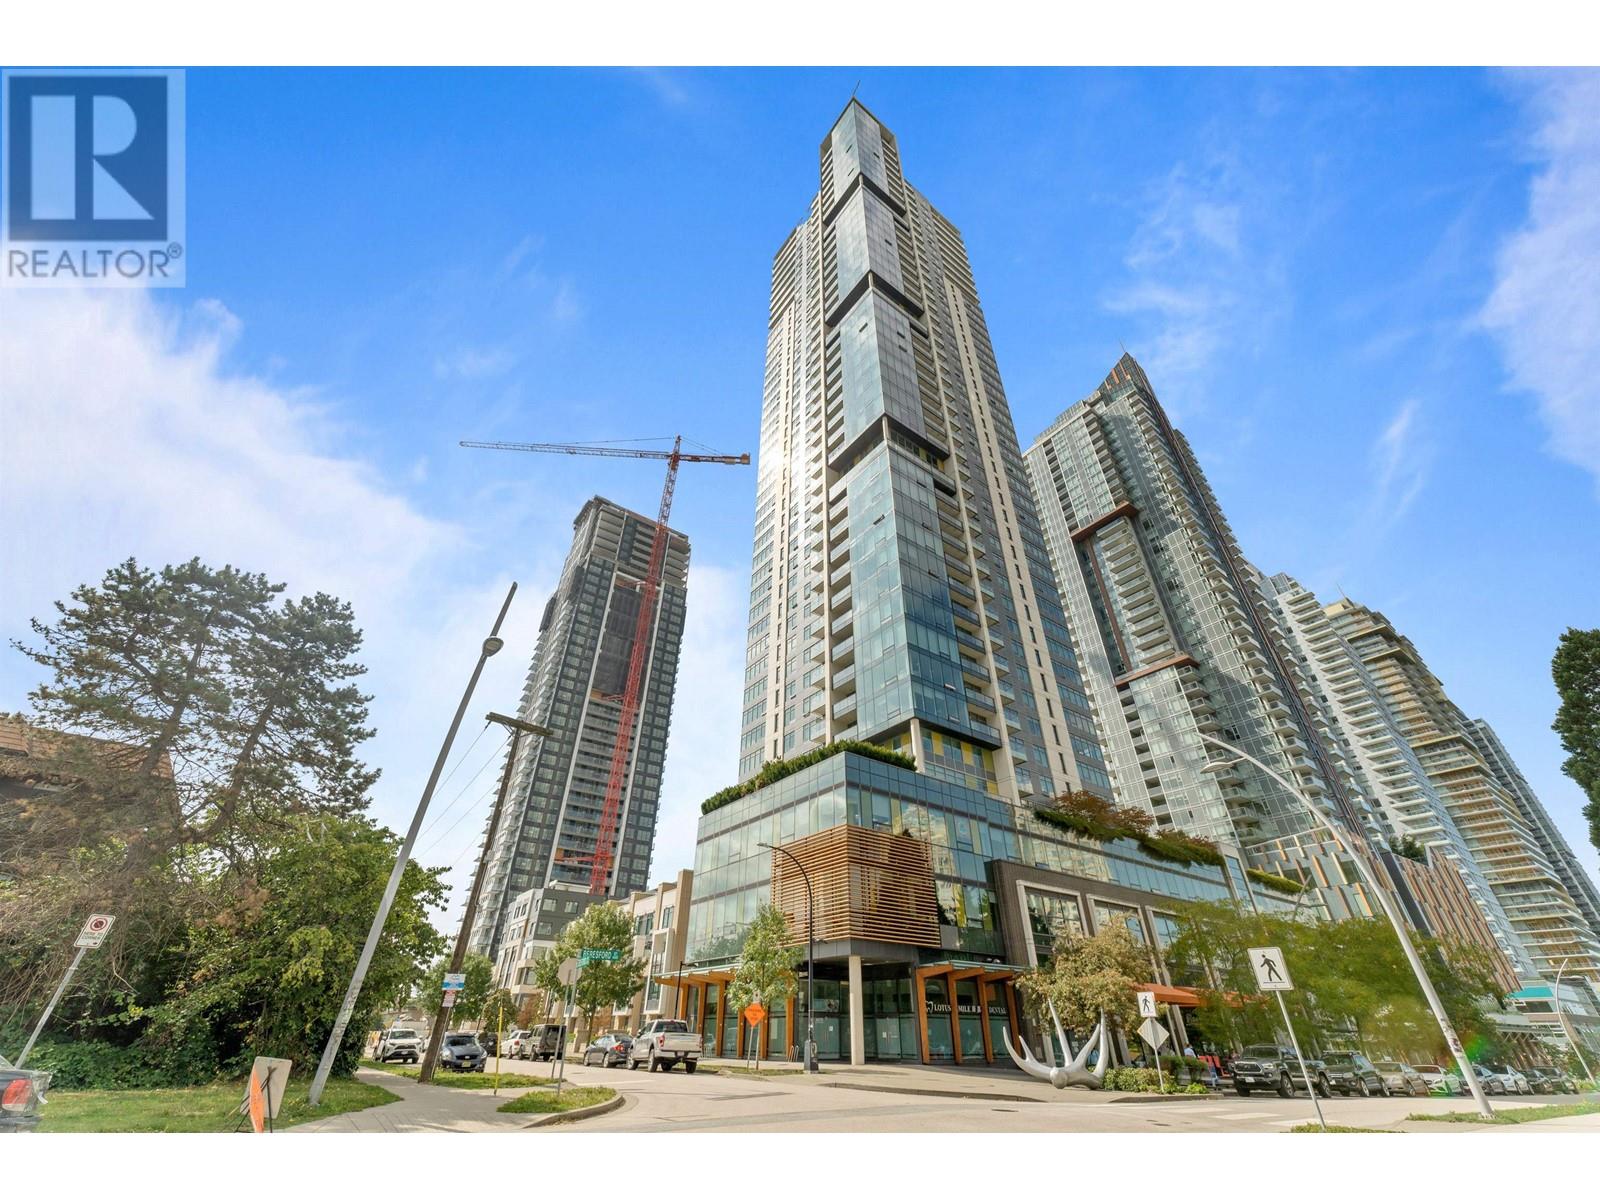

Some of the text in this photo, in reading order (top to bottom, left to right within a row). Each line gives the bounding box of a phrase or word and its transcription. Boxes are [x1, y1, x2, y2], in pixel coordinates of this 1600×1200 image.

[583, 950, 611, 959] BERESFORD
[934, 1004, 951, 1012] LOTUS
[989, 1006, 1006, 1014] DENTAL
